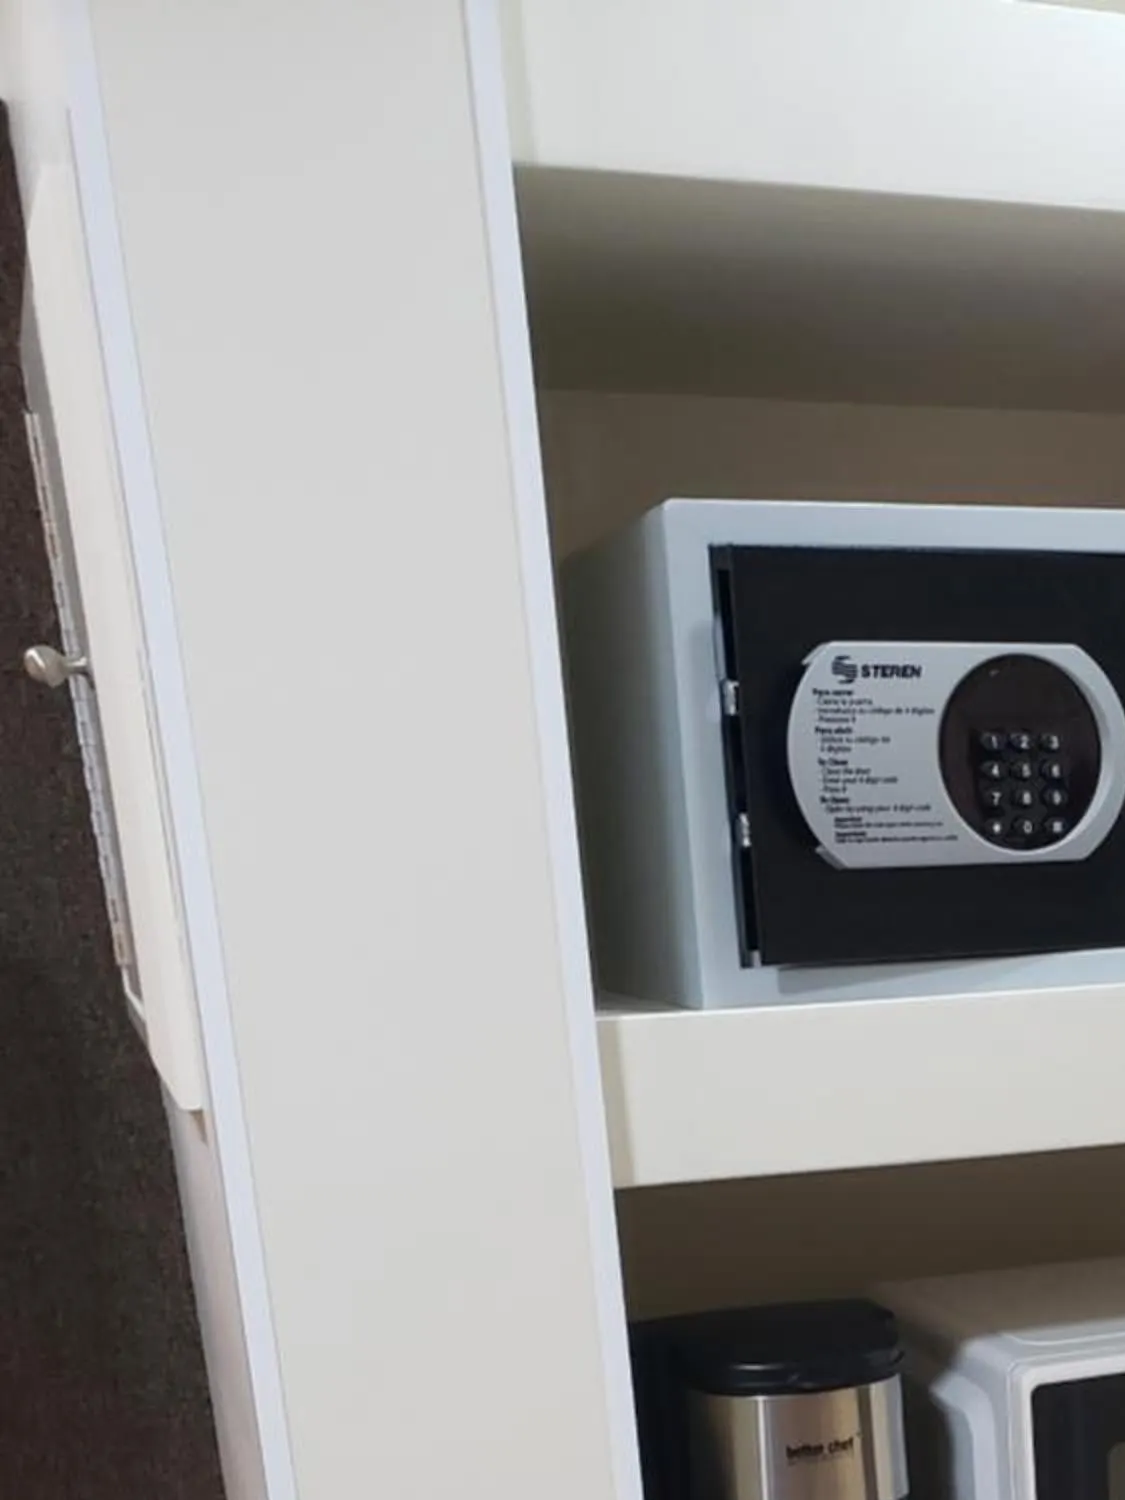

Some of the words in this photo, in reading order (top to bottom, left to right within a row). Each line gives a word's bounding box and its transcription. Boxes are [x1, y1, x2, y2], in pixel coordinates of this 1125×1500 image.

[861, 664, 922, 679] STEREN
[991, 735, 998, 749] 1
[1020, 735, 1029, 749] 2
[1050, 735, 1059, 749] 3
[991, 764, 1000, 777] 4
[1022, 764, 1031, 778] 5
[1052, 764, 1060, 778] 6
[991, 792, 1001, 805] 7
[1022, 791, 1031, 805] 8
[1052, 791, 1061, 805] 9
[1023, 820, 1032, 834] 0
[786, 1443, 824, 1459] better
[828, 1437, 854, 1453] chef
